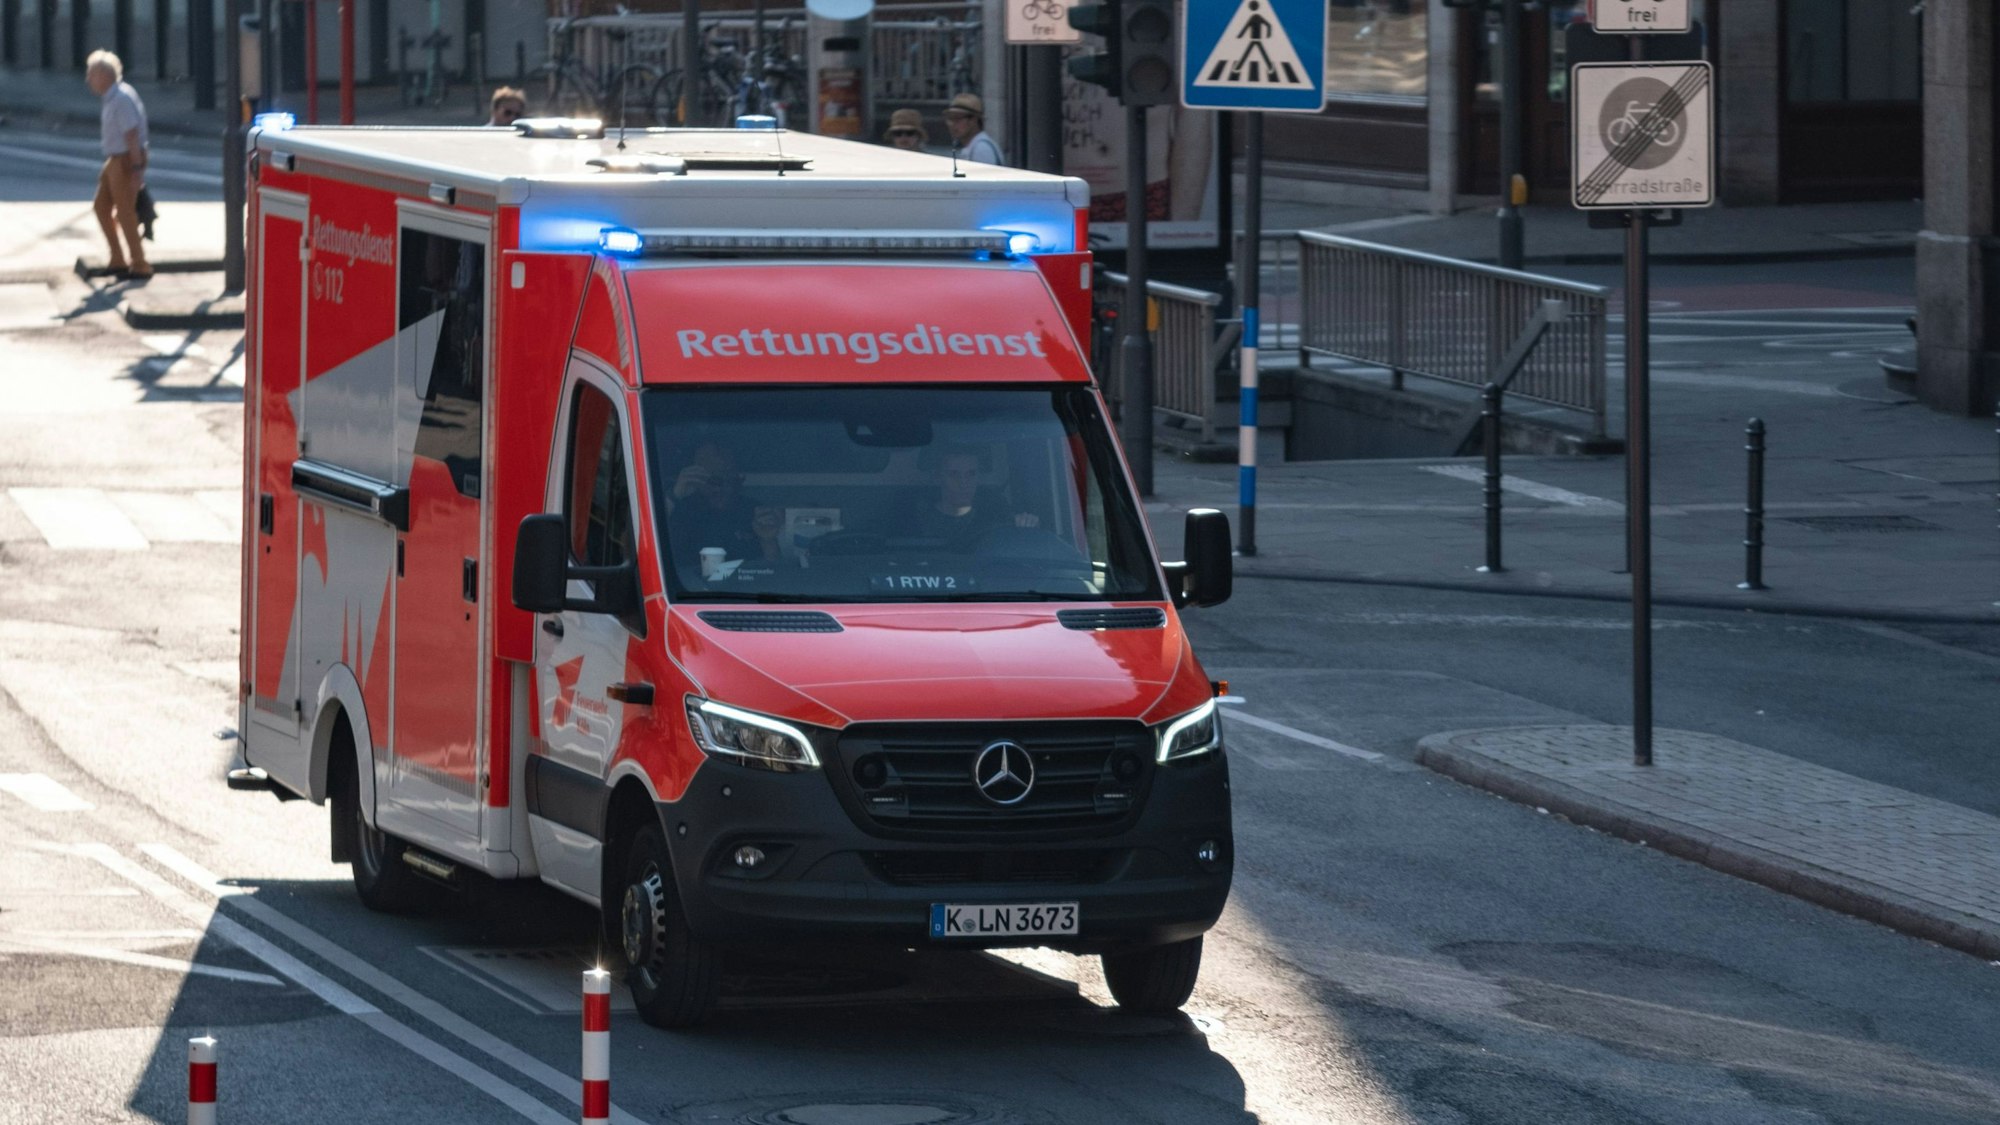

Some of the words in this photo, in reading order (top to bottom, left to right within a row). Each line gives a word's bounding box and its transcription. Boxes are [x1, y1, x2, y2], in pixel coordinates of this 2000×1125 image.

[1628, 7, 1657, 22] frei
[1032, 23, 1056, 35] frei
[1586, 178, 1703, 195] rradstraße
[313, 214, 393, 267] Rettungsdienst
[325, 267, 344, 304] 112
[676, 324, 1047, 364] Rettungsdienst
[886, 576, 894, 588] 1
[900, 576, 940, 588] RTW
[945, 576, 957, 588] 2
[947, 908, 962, 932] K
[979, 908, 1010, 932] LN
[1016, 907, 1075, 931] 3673
